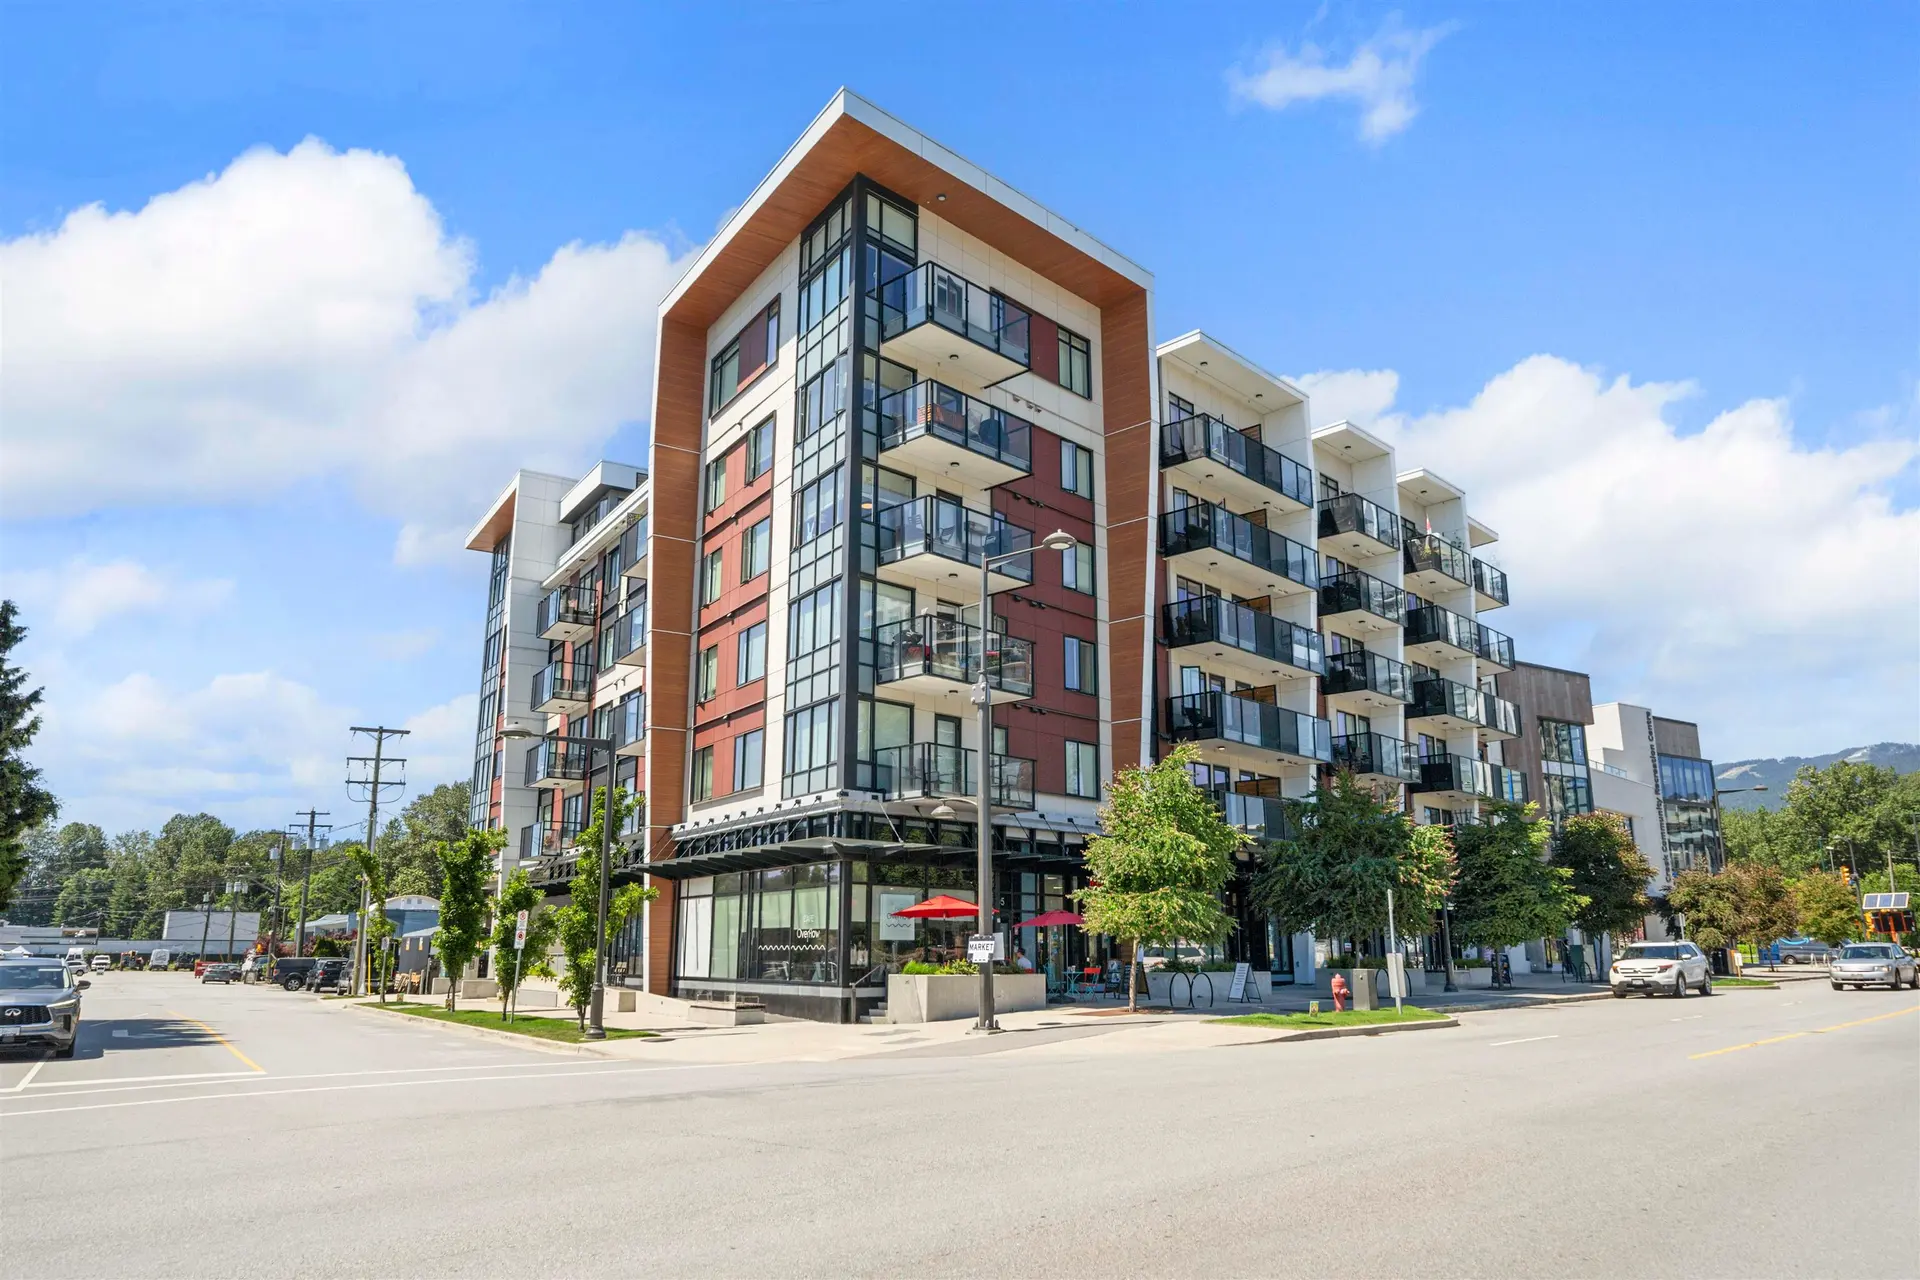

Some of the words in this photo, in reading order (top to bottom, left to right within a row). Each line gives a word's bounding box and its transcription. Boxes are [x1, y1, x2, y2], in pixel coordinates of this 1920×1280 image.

[1646, 711, 1654, 742] Centre
[1650, 744, 1660, 795] Recreation
[1656, 797, 1668, 853] Community
[1663, 854, 1671, 883] Creek
[797, 928, 820, 942] Overflow
[969, 943, 993, 951] MARKET
